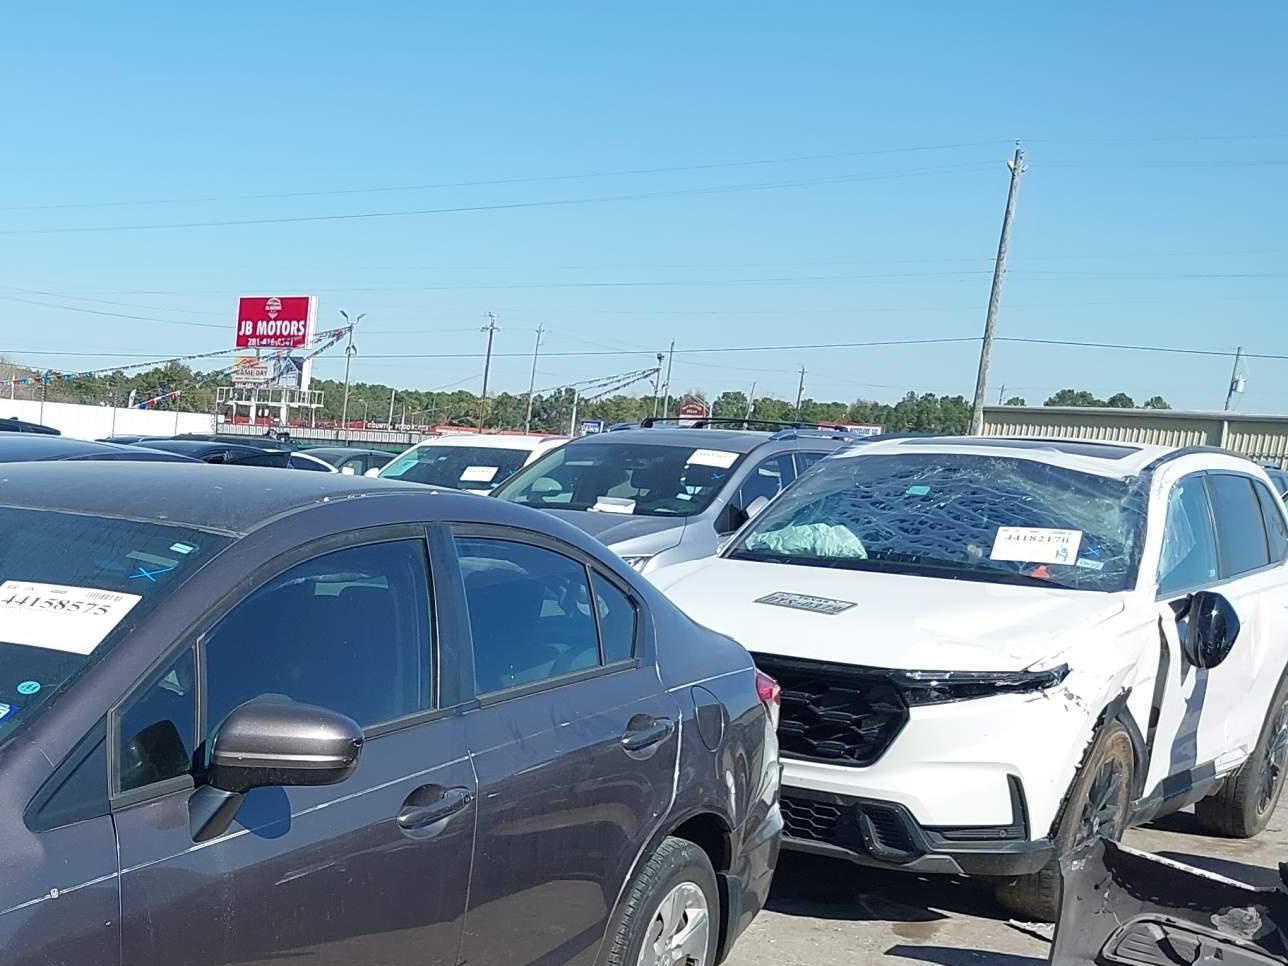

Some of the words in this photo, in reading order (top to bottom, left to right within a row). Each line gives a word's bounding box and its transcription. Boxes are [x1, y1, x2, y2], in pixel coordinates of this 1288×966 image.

[239, 320, 253, 336] JB
[256, 320, 305, 336] MOTORS
[1, 594, 112, 616] 44158575
